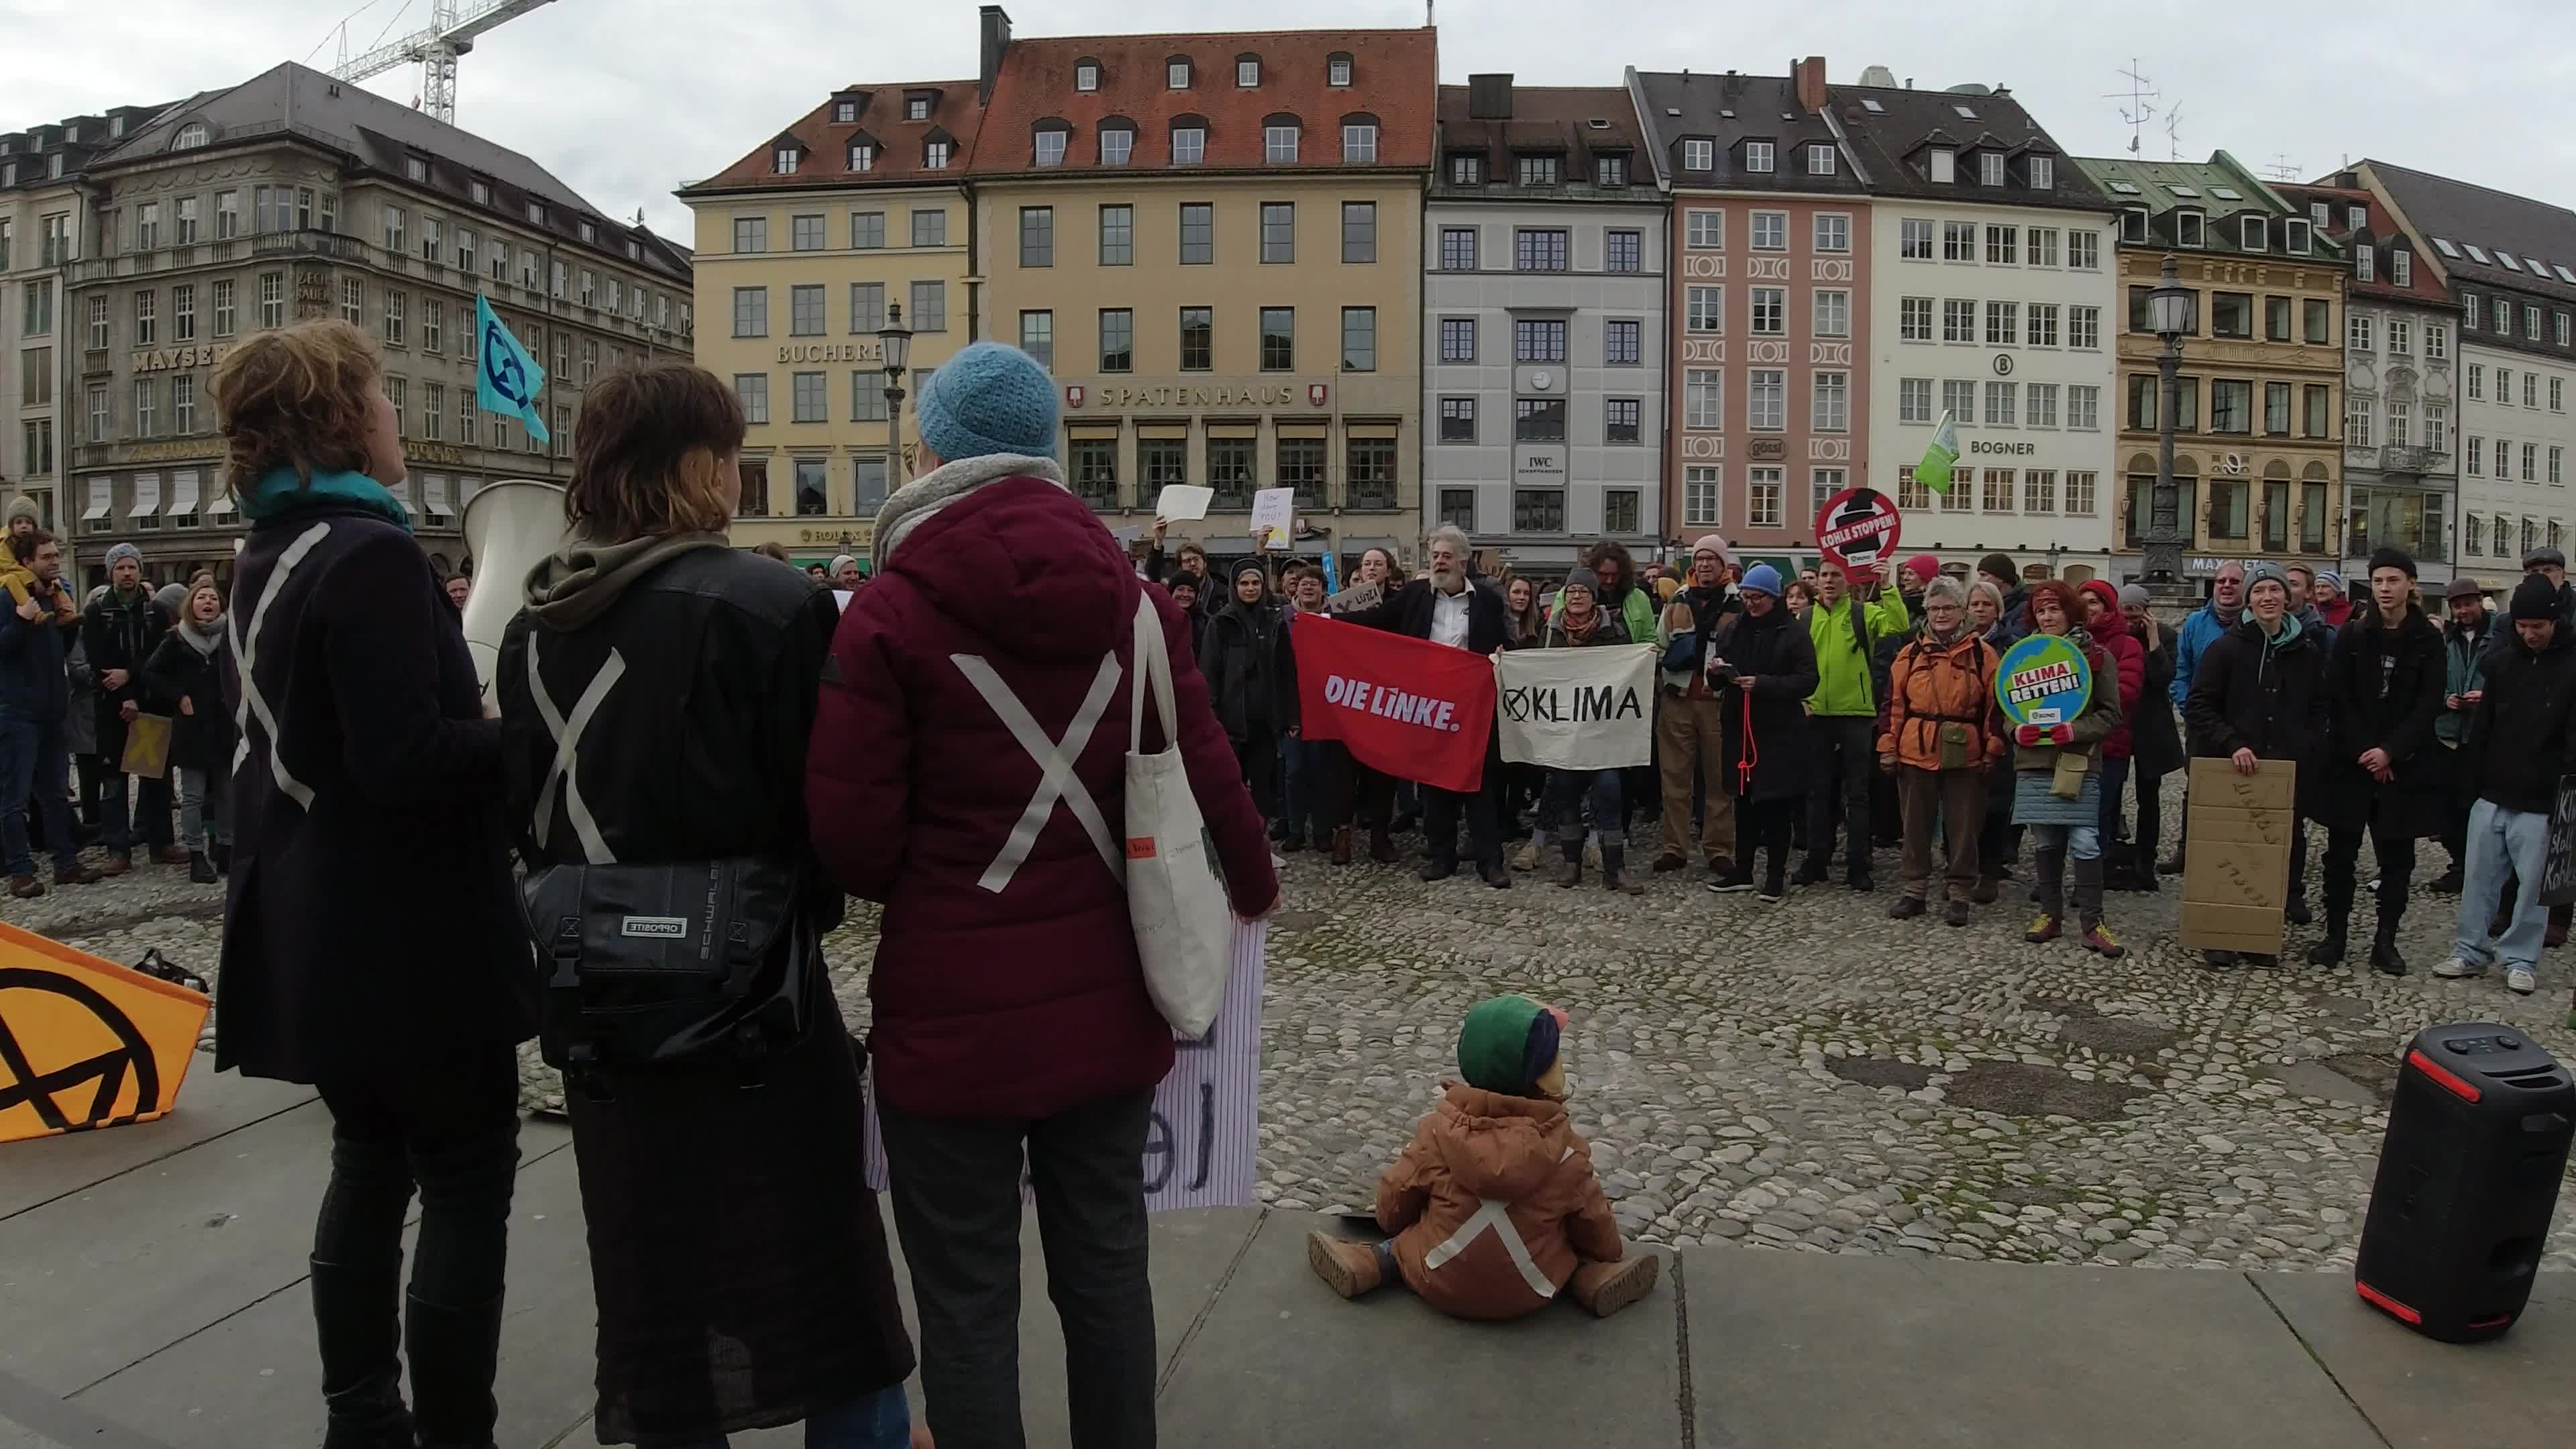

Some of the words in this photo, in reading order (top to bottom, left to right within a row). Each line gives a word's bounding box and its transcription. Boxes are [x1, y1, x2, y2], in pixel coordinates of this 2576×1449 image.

[1100, 387, 1293, 406] SPATENHAUS
[1971, 441, 2035, 455] BOGNER
[1529, 457, 1552, 468] IWC
[1820, 528, 1852, 548] KOHLE
[1851, 513, 1896, 539] STOPPEN!
[2192, 557, 2224, 570] MAX
[2014, 663, 2069, 688] KLIMA
[1324, 675, 1371, 710] DIE
[2010, 676, 2080, 704] RETTEN!
[1532, 686, 1642, 722] KLIMA
